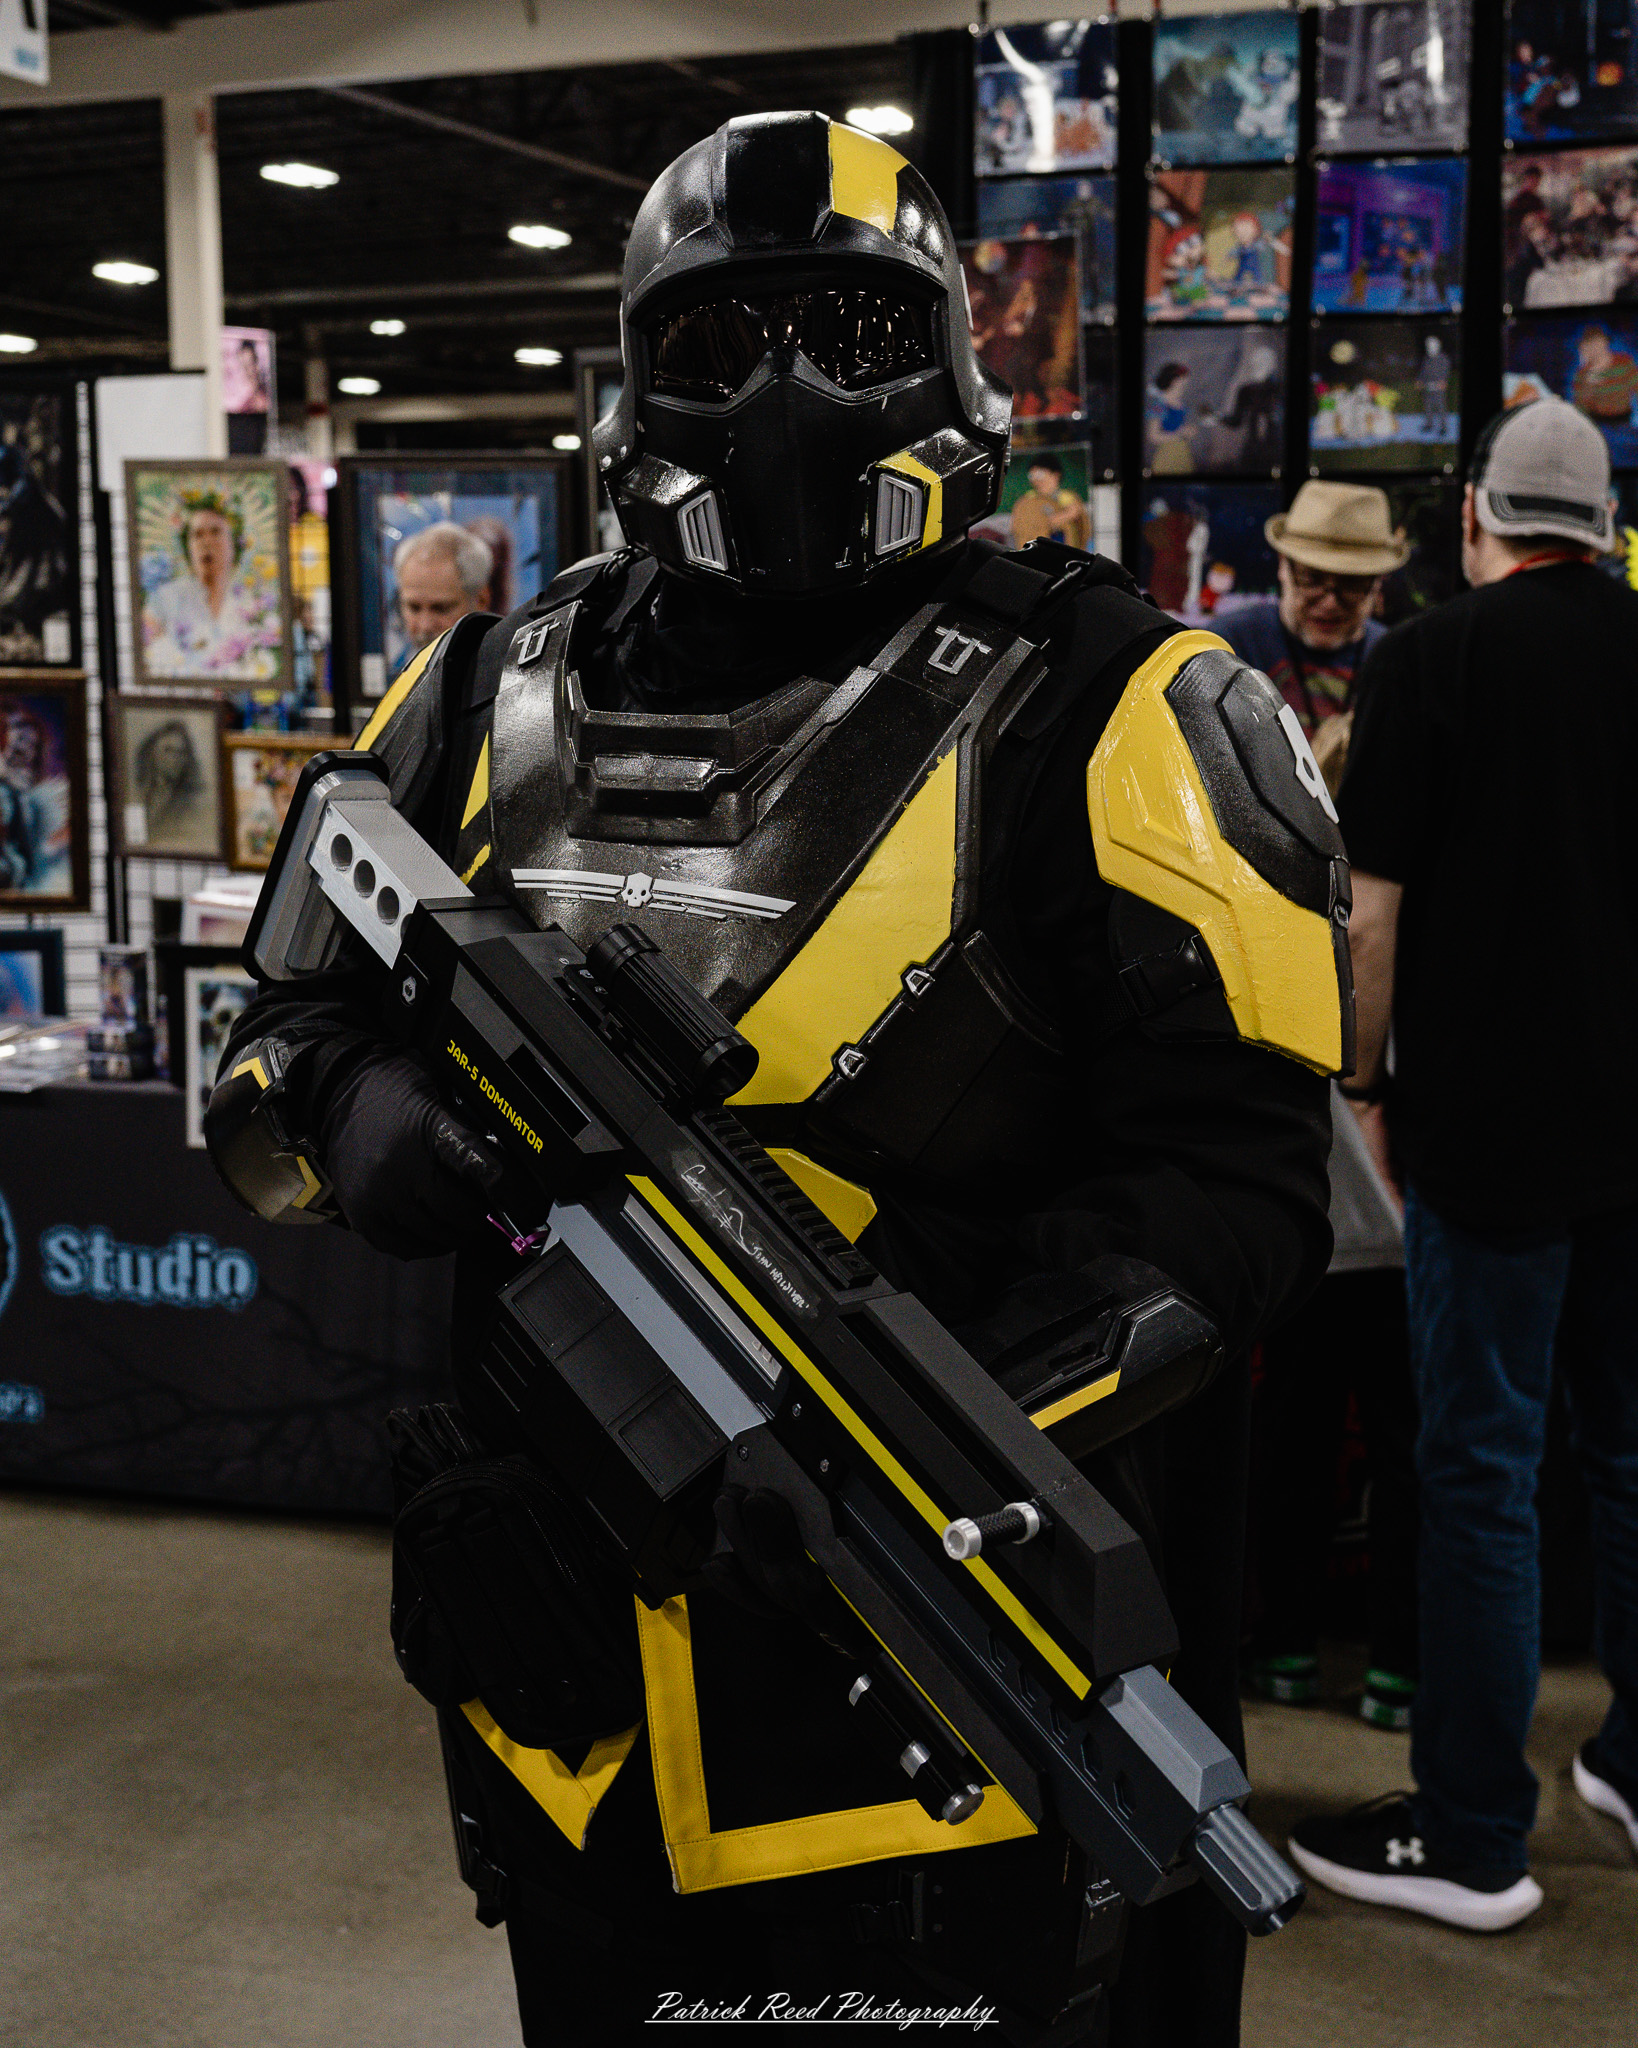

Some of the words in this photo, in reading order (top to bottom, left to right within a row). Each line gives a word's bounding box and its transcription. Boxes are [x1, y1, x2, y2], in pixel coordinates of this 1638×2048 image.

[446, 1039, 479, 1081] JAR-5
[479, 1075, 544, 1154] DOMINATOR
[43, 1229, 255, 1307] Studio
